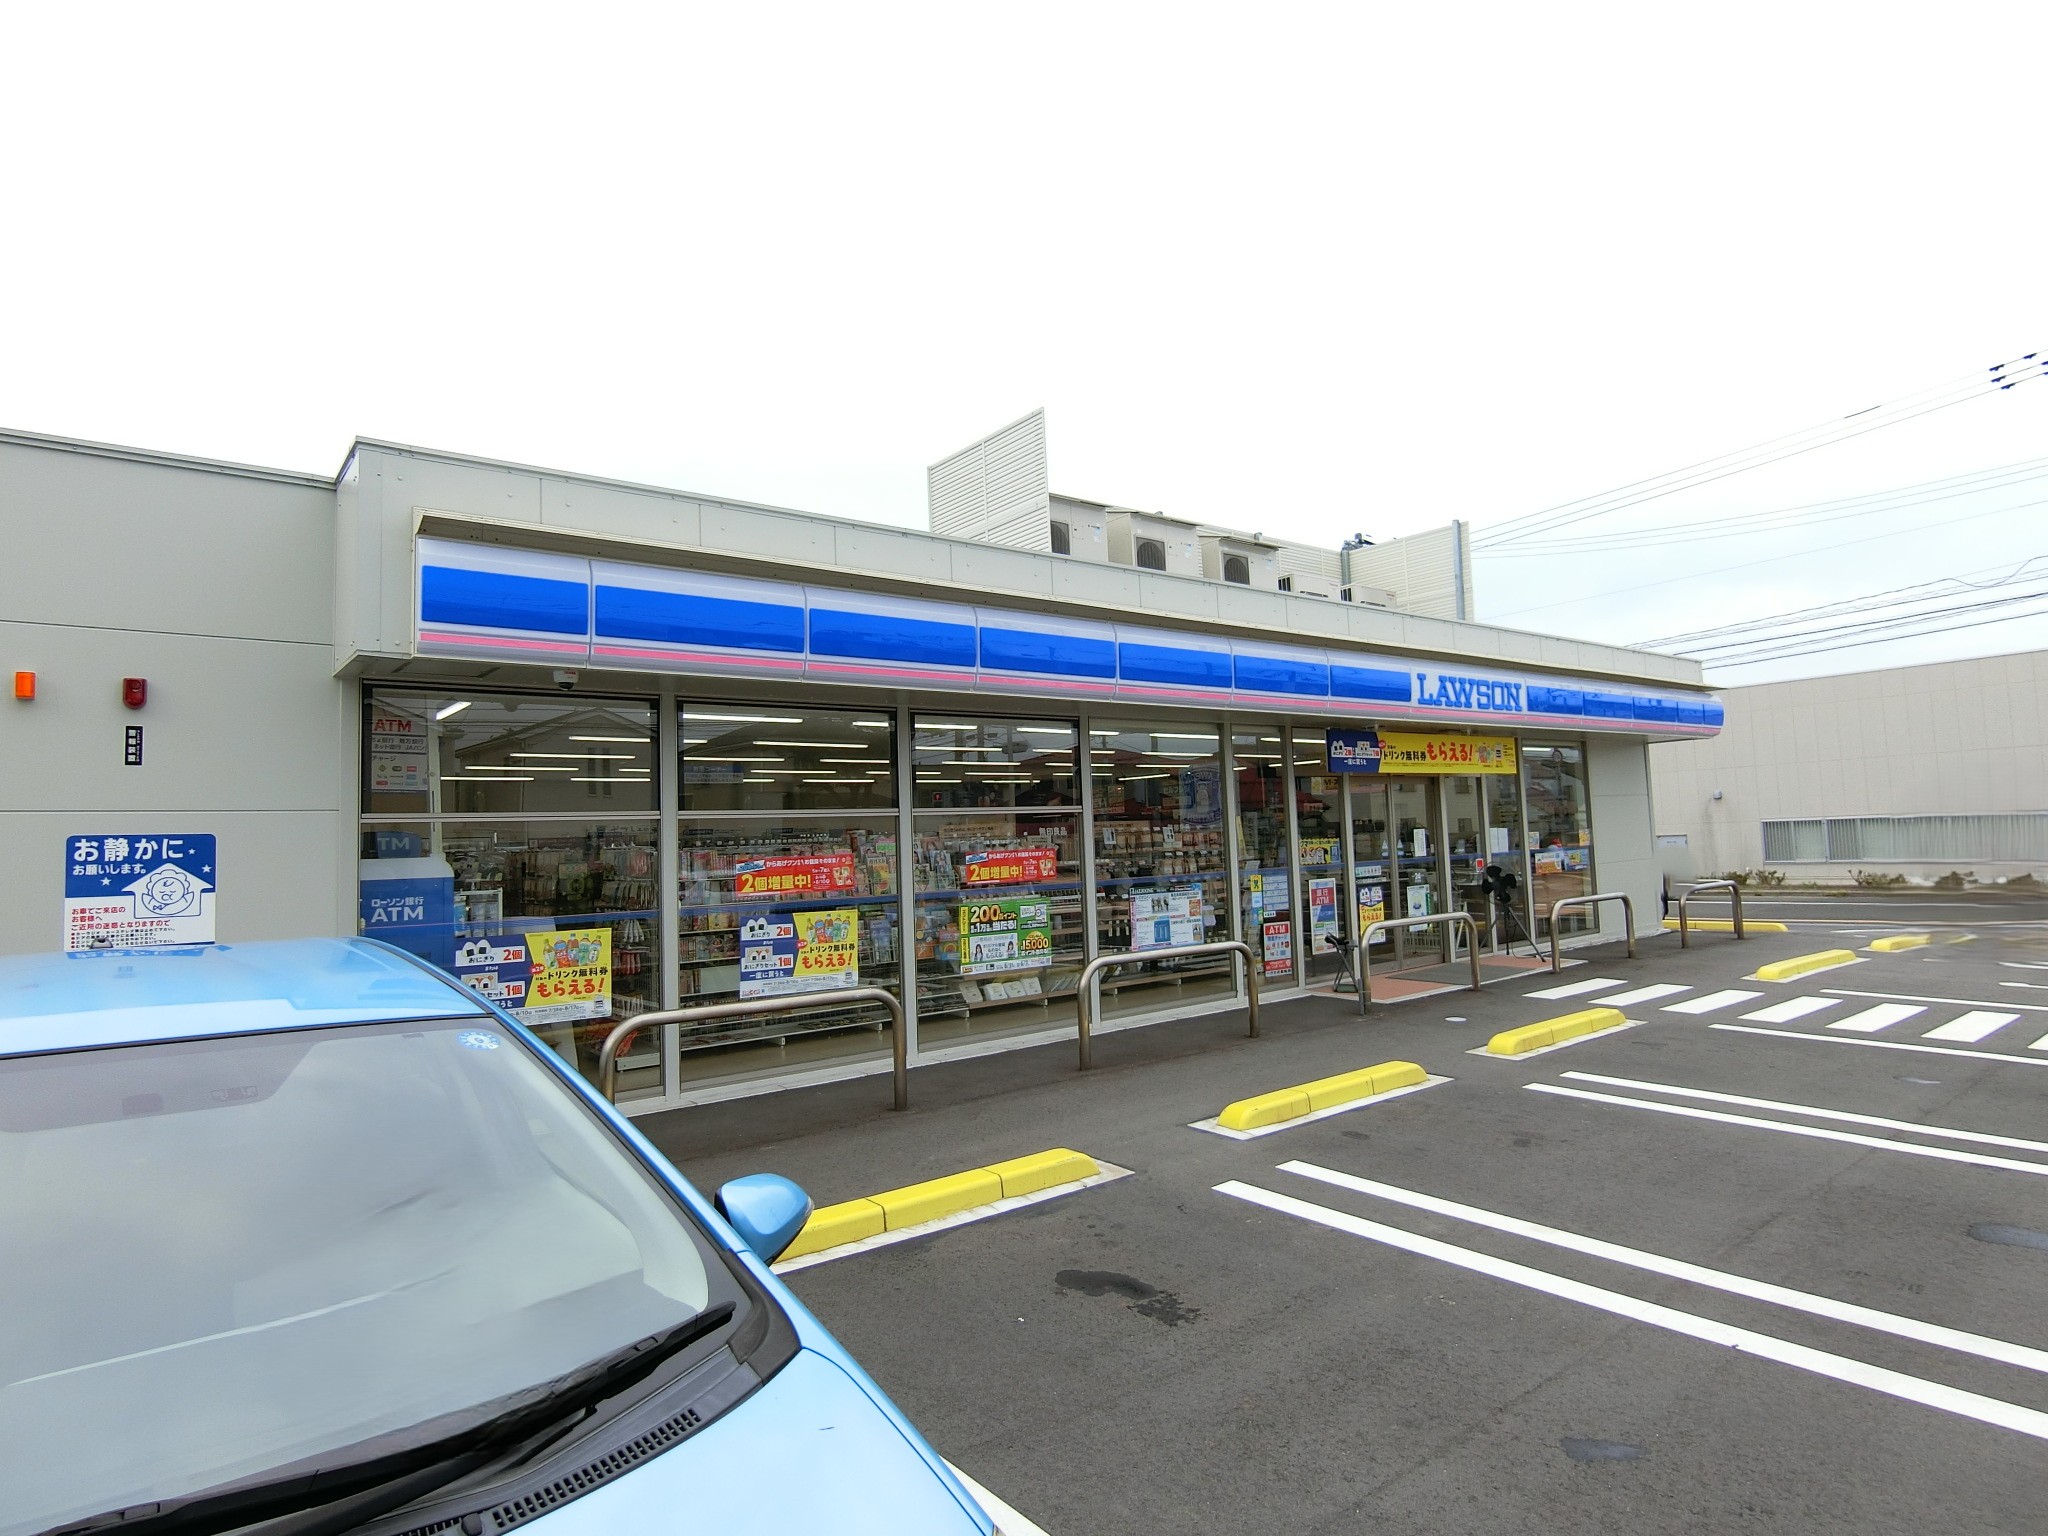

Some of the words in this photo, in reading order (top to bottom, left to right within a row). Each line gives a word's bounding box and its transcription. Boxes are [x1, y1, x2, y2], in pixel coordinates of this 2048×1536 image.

[1417, 673, 1522, 711] LAWSON
[374, 719, 412, 732] ATM
[1383, 751, 1427, 762] ドリンク無料券
[1427, 741, 1473, 762] もらえる!
[74, 838, 184, 862] お静かに
[377, 837, 410, 850] TM
[73, 863, 147, 875] お願いします。
[970, 865, 1022, 880] 2個増量中!
[741, 874, 811, 892] 2個増量中!
[371, 896, 424, 907] ローソン銀行
[1316, 896, 1330, 905] ATM
[371, 906, 424, 923] ATM
[777, 926, 791, 936] 2個
[1269, 926, 1286, 935] ATM
[810, 943, 855, 953] ドリンク無料券
[503, 949, 522, 961] 2個
[802, 953, 852, 969] もらえる!
[778, 957, 791, 967] 1個
[548, 966, 608, 980] ドリンク無料券
[505, 984, 522, 996] 1個
[537, 978, 604, 998] もらえる!
